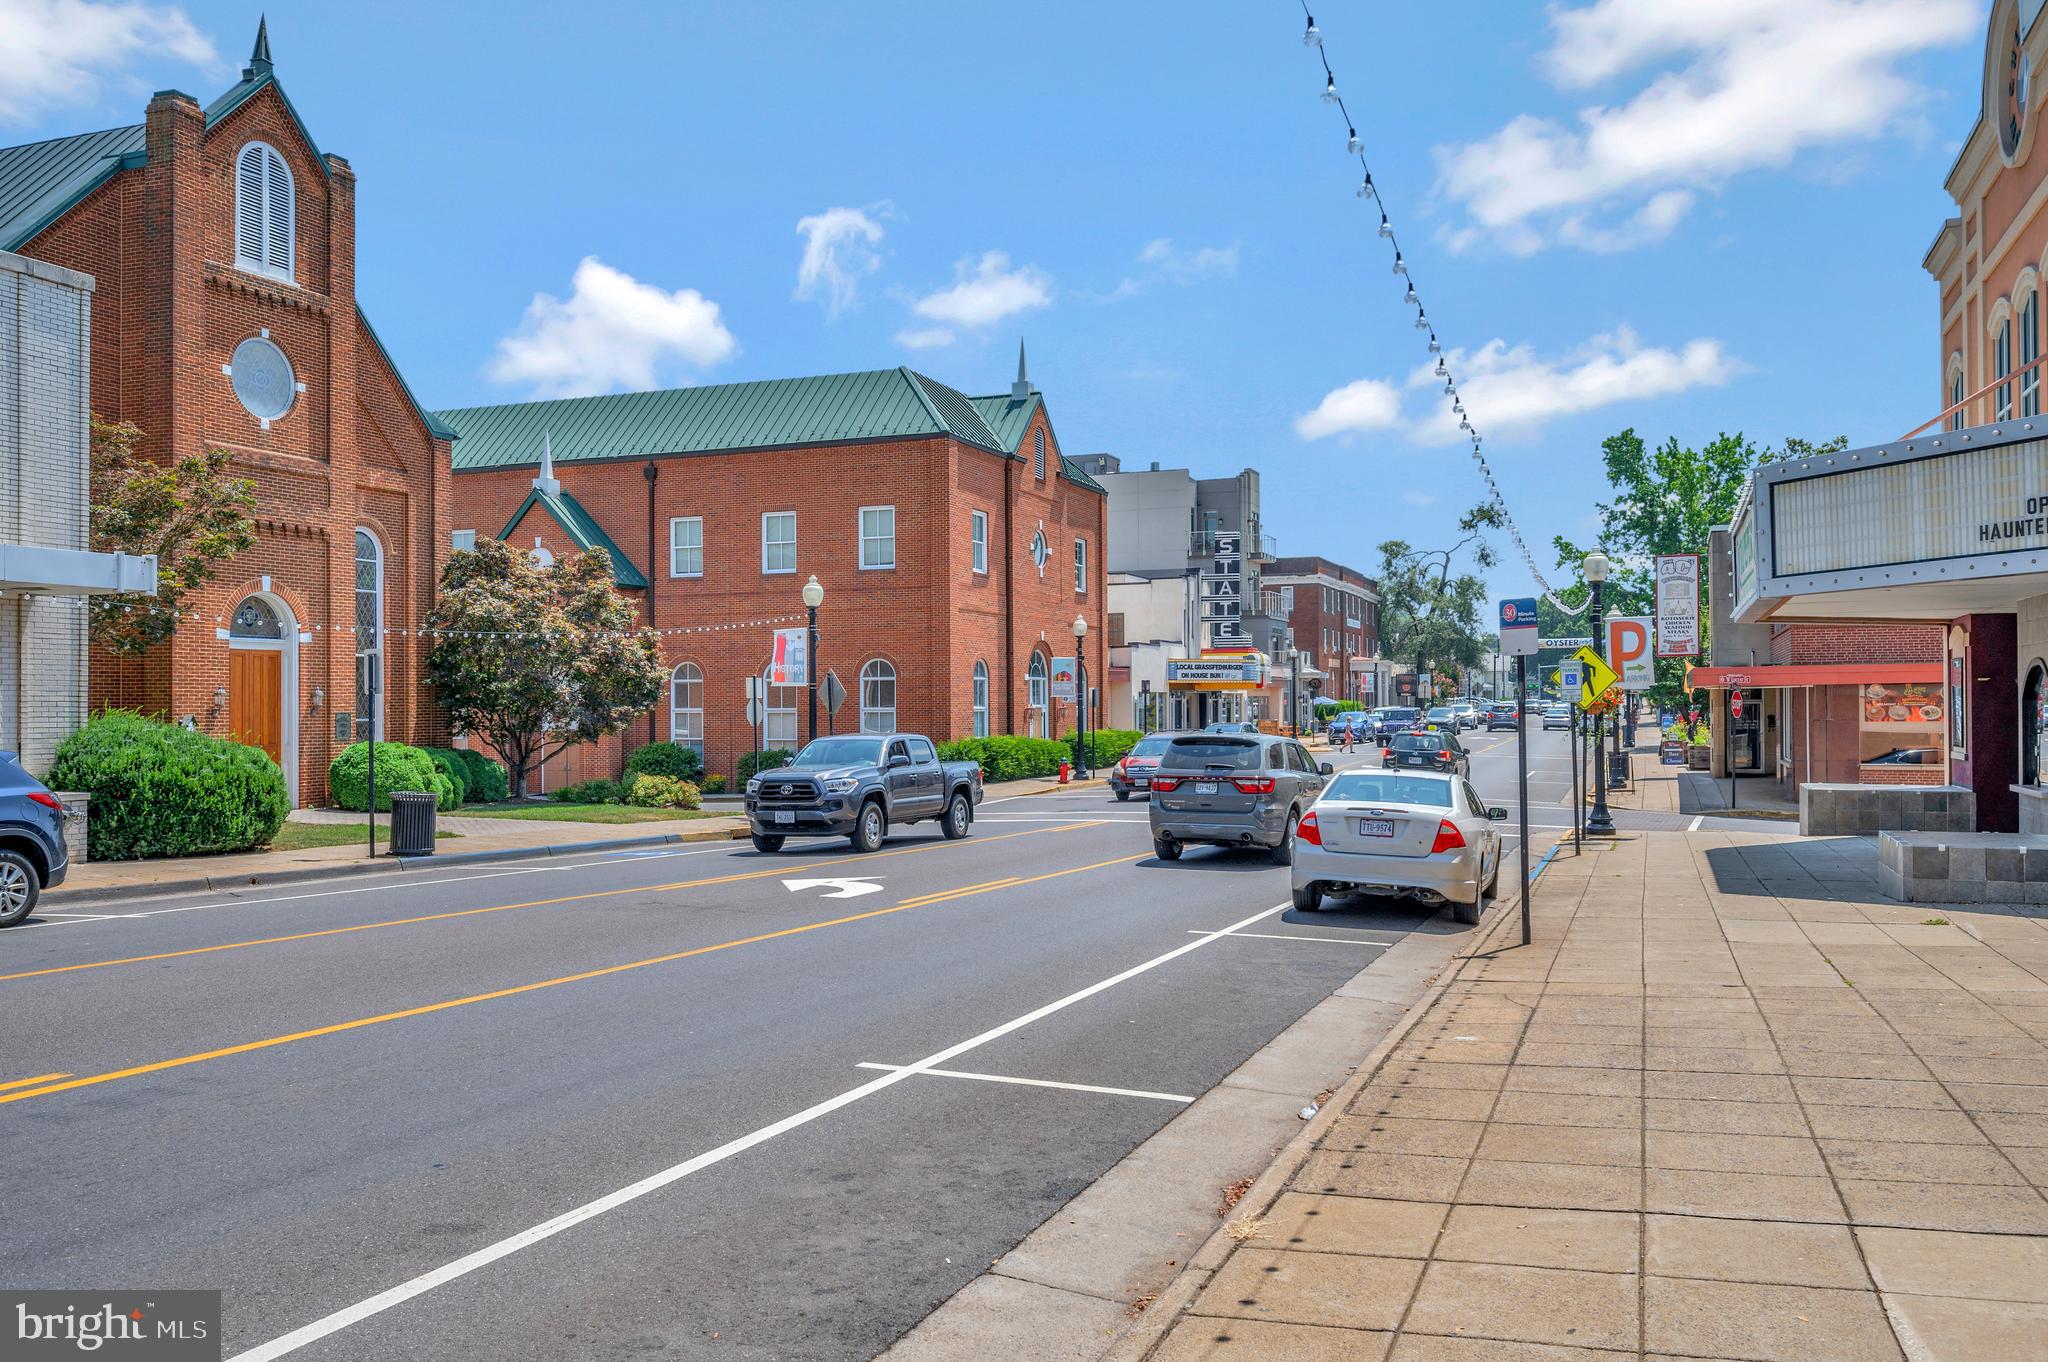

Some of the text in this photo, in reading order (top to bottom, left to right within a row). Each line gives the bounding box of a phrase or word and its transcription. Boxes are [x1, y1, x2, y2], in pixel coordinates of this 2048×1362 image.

[1979, 517, 2048, 541] HAUNTE
[1219, 539, 1233, 636] STATE
[1505, 608, 1515, 619] 30
[1609, 621, 1646, 682] P
[775, 661, 805, 673] HISTORY
[1731, 700, 1742, 709] STOP
[1362, 823, 1392, 833] TTU-9574
